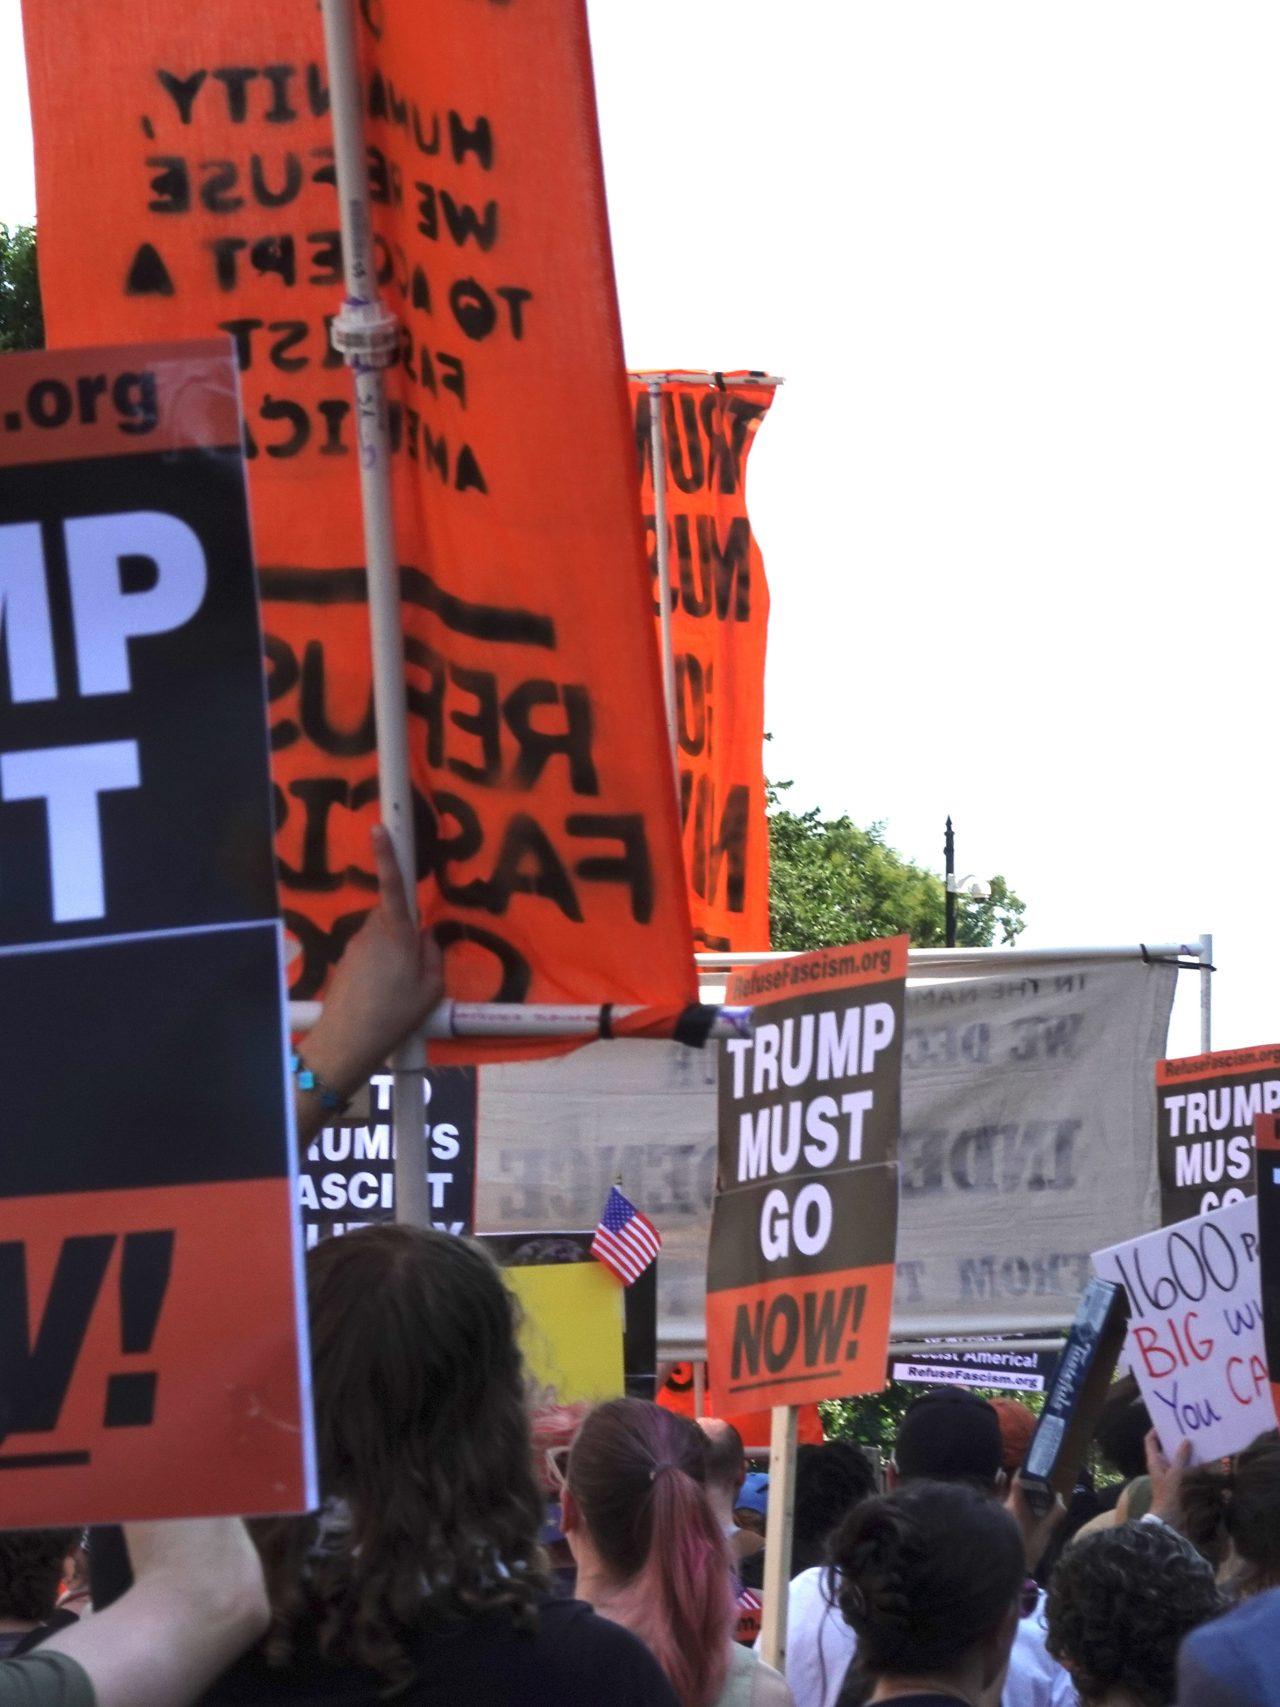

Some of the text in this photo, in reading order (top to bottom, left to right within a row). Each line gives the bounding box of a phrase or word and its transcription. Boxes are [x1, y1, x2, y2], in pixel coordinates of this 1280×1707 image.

[734, 949, 892, 1000] RefuseFascism.org
[727, 1002, 896, 1099] TRUMP
[737, 1089, 874, 1182] MUST
[1175, 1135, 1256, 1187] MUS
[299, 1171, 453, 1210] ASCIT
[760, 1182, 832, 1262] GO
[1115, 1222, 1239, 1318] 1600
[731, 1284, 868, 1380] NOW!
[963, 1351, 1038, 1368] America!
[1132, 1311, 1215, 1379] BIG
[908, 1366, 1038, 1389] RefuseFascism.org
[1154, 1381, 1222, 1435] You
